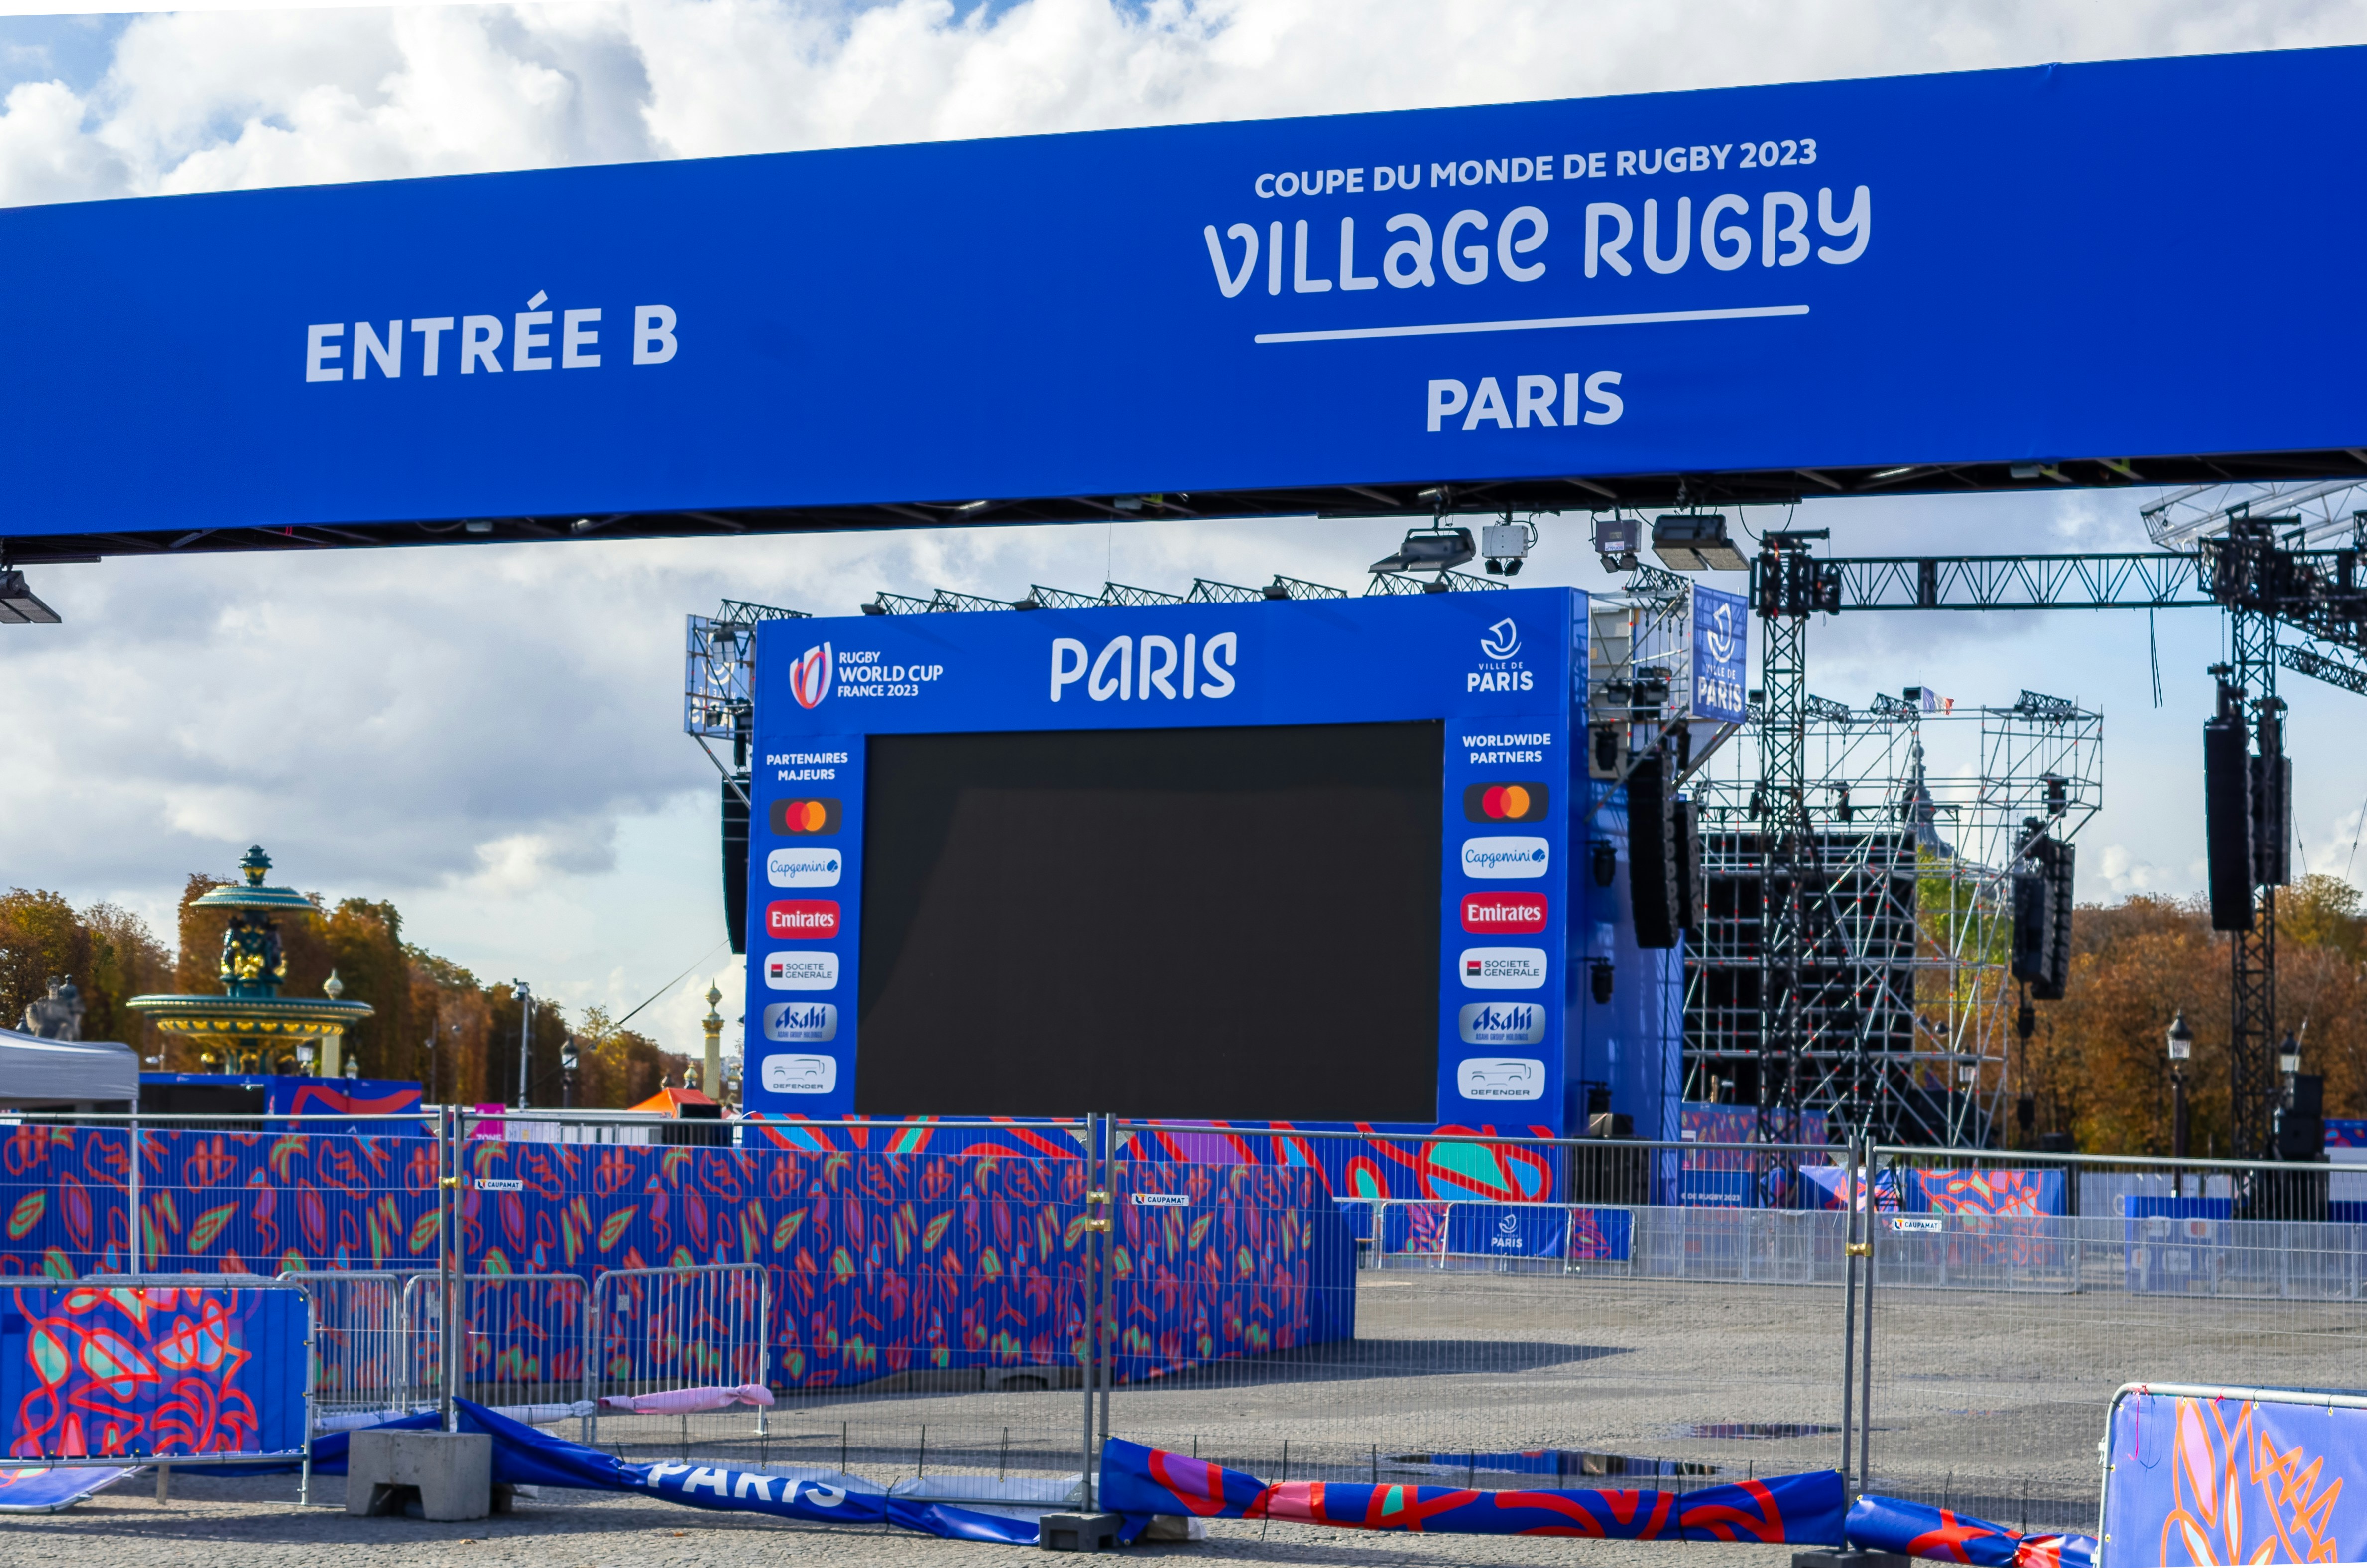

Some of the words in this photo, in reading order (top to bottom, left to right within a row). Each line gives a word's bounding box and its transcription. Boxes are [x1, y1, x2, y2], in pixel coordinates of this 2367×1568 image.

[1255, 168, 1363, 198] COUPE
[1374, 165, 1420, 191] DU
[1431, 155, 1553, 188] MONDE
[1564, 153, 1606, 179] DE
[1617, 144, 1732, 176] RUGBY
[1739, 138, 1817, 168] 2023
[306, 289, 601, 382] ENTRÉE
[633, 304, 678, 365] B
[1427, 370, 1624, 432] PARIS
[839, 651, 881, 664] RUGBY
[1478, 662, 1506, 670] VILLE
[839, 666, 905, 683] WORLD
[908, 665, 943, 682] CUP
[1050, 632, 1237, 702] PARIS
[1706, 663, 1725, 677] VILLE
[1727, 669, 1736, 680] DE
[837, 684, 884, 697] FRANCE
[887, 684, 919, 697] 2023
[1467, 671, 1534, 692] PARIS
[1697, 675, 1742, 713] PARIS
[1462, 733, 1551, 747] WORLDWIDE
[766, 752, 848, 765] PARTENAIRES
[1470, 750, 1542, 764] PARTNERS
[778, 769, 835, 781] MAJEURS
[1465, 849, 1530, 869] Capgemini
[770, 860, 825, 878] Capgemini
[772, 910, 834, 928] Emirates
[1468, 903, 1541, 921] Emirates
[775, 1006, 826, 1029] Asahi
[1472, 1006, 1532, 1031] Asahi
[1491, 1237, 1523, 1248] PARIS
[647, 1463, 846, 1507] PARIS
